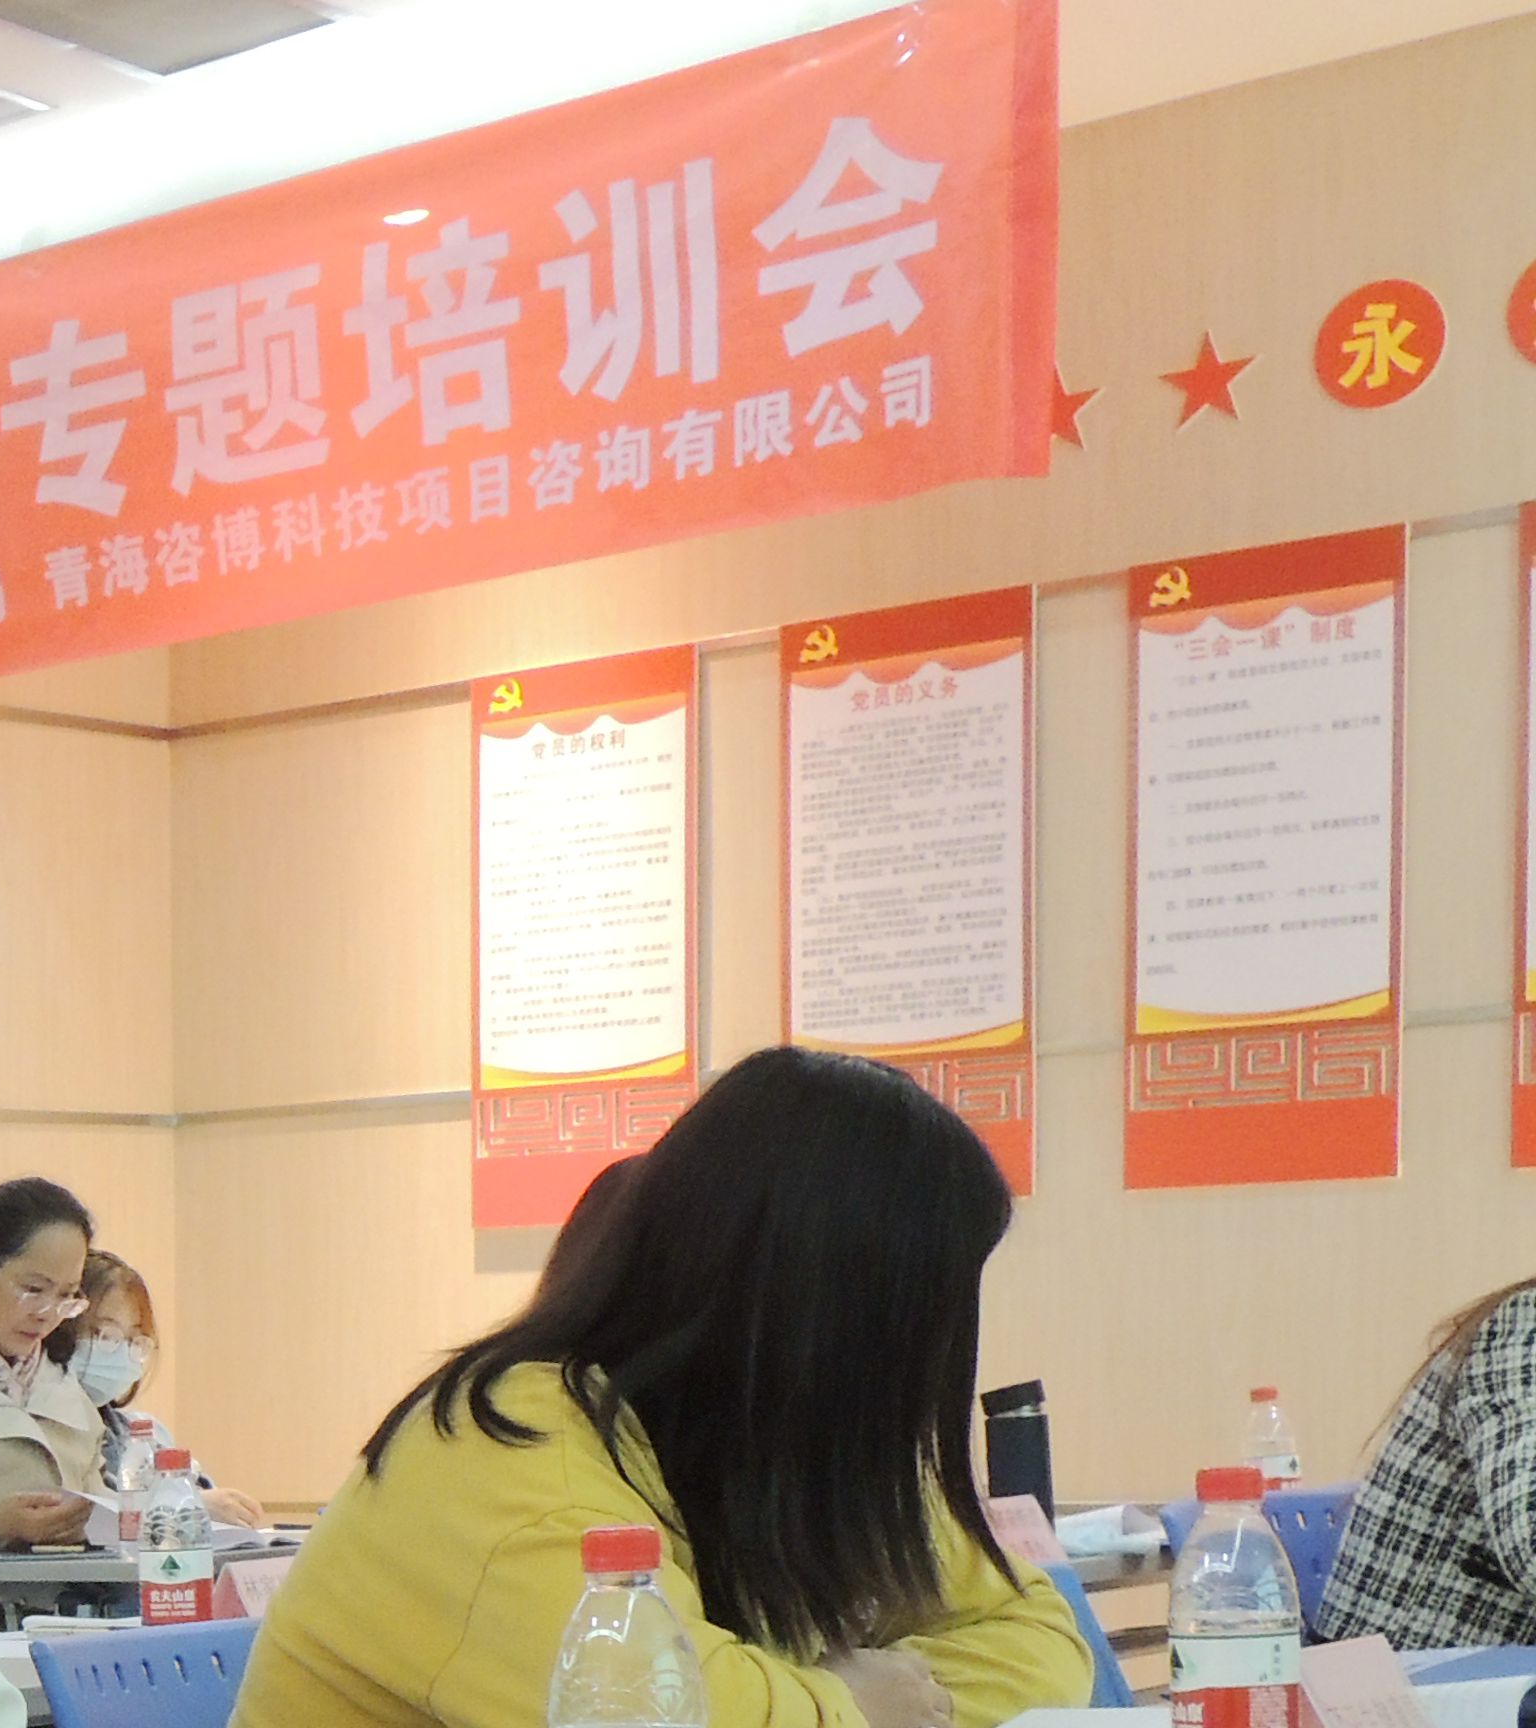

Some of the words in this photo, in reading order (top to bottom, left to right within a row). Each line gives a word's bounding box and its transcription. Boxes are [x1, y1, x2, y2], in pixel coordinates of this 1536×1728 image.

[1337, 303, 1424, 389] 永
[45, 355, 933, 611] 青海咨博科技项目咨询有限公司
[850, 676, 960, 712] 党员的义务
[532, 727, 627, 760] 党员的权利
